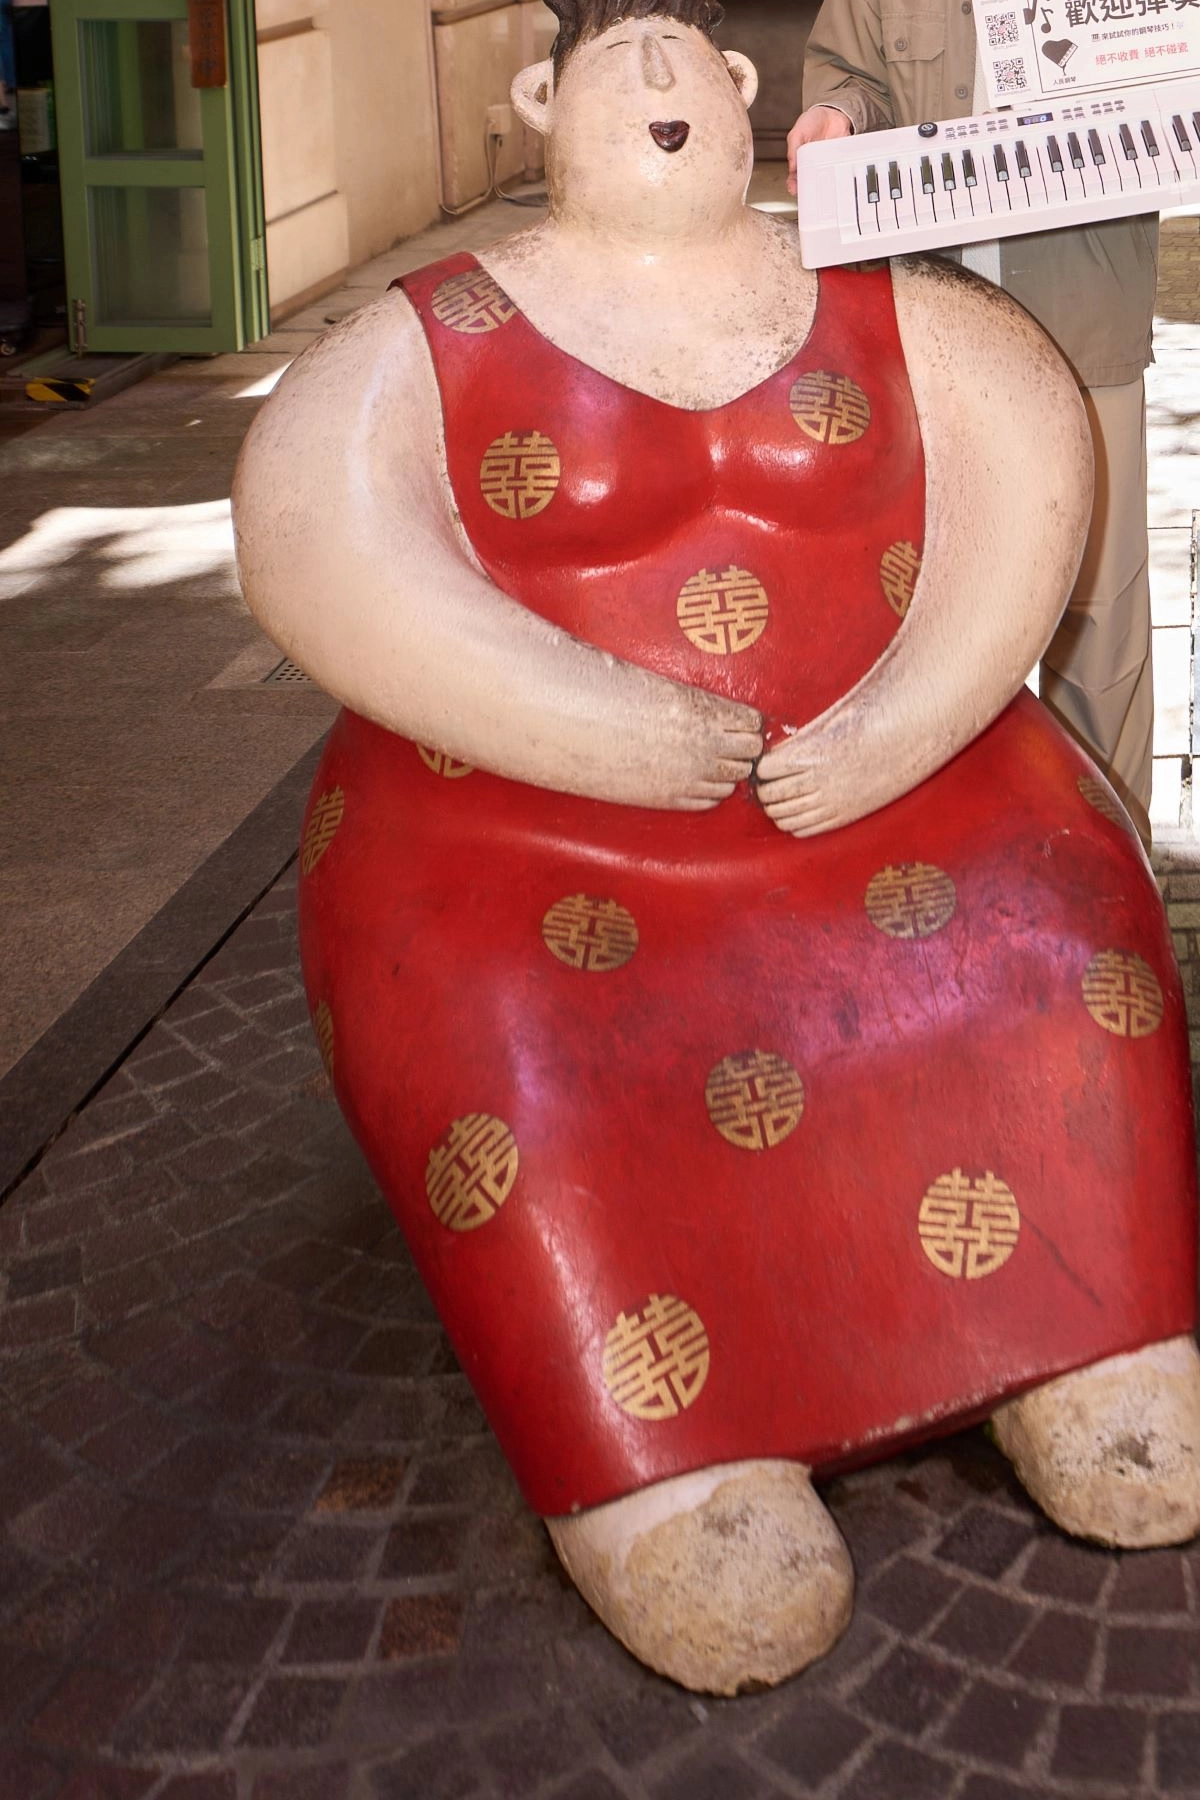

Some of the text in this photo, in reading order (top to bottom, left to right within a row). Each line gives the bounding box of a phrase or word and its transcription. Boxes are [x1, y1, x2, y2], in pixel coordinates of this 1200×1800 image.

[1095, 42, 1189, 66] 絕不收費 絕不碰瓷
